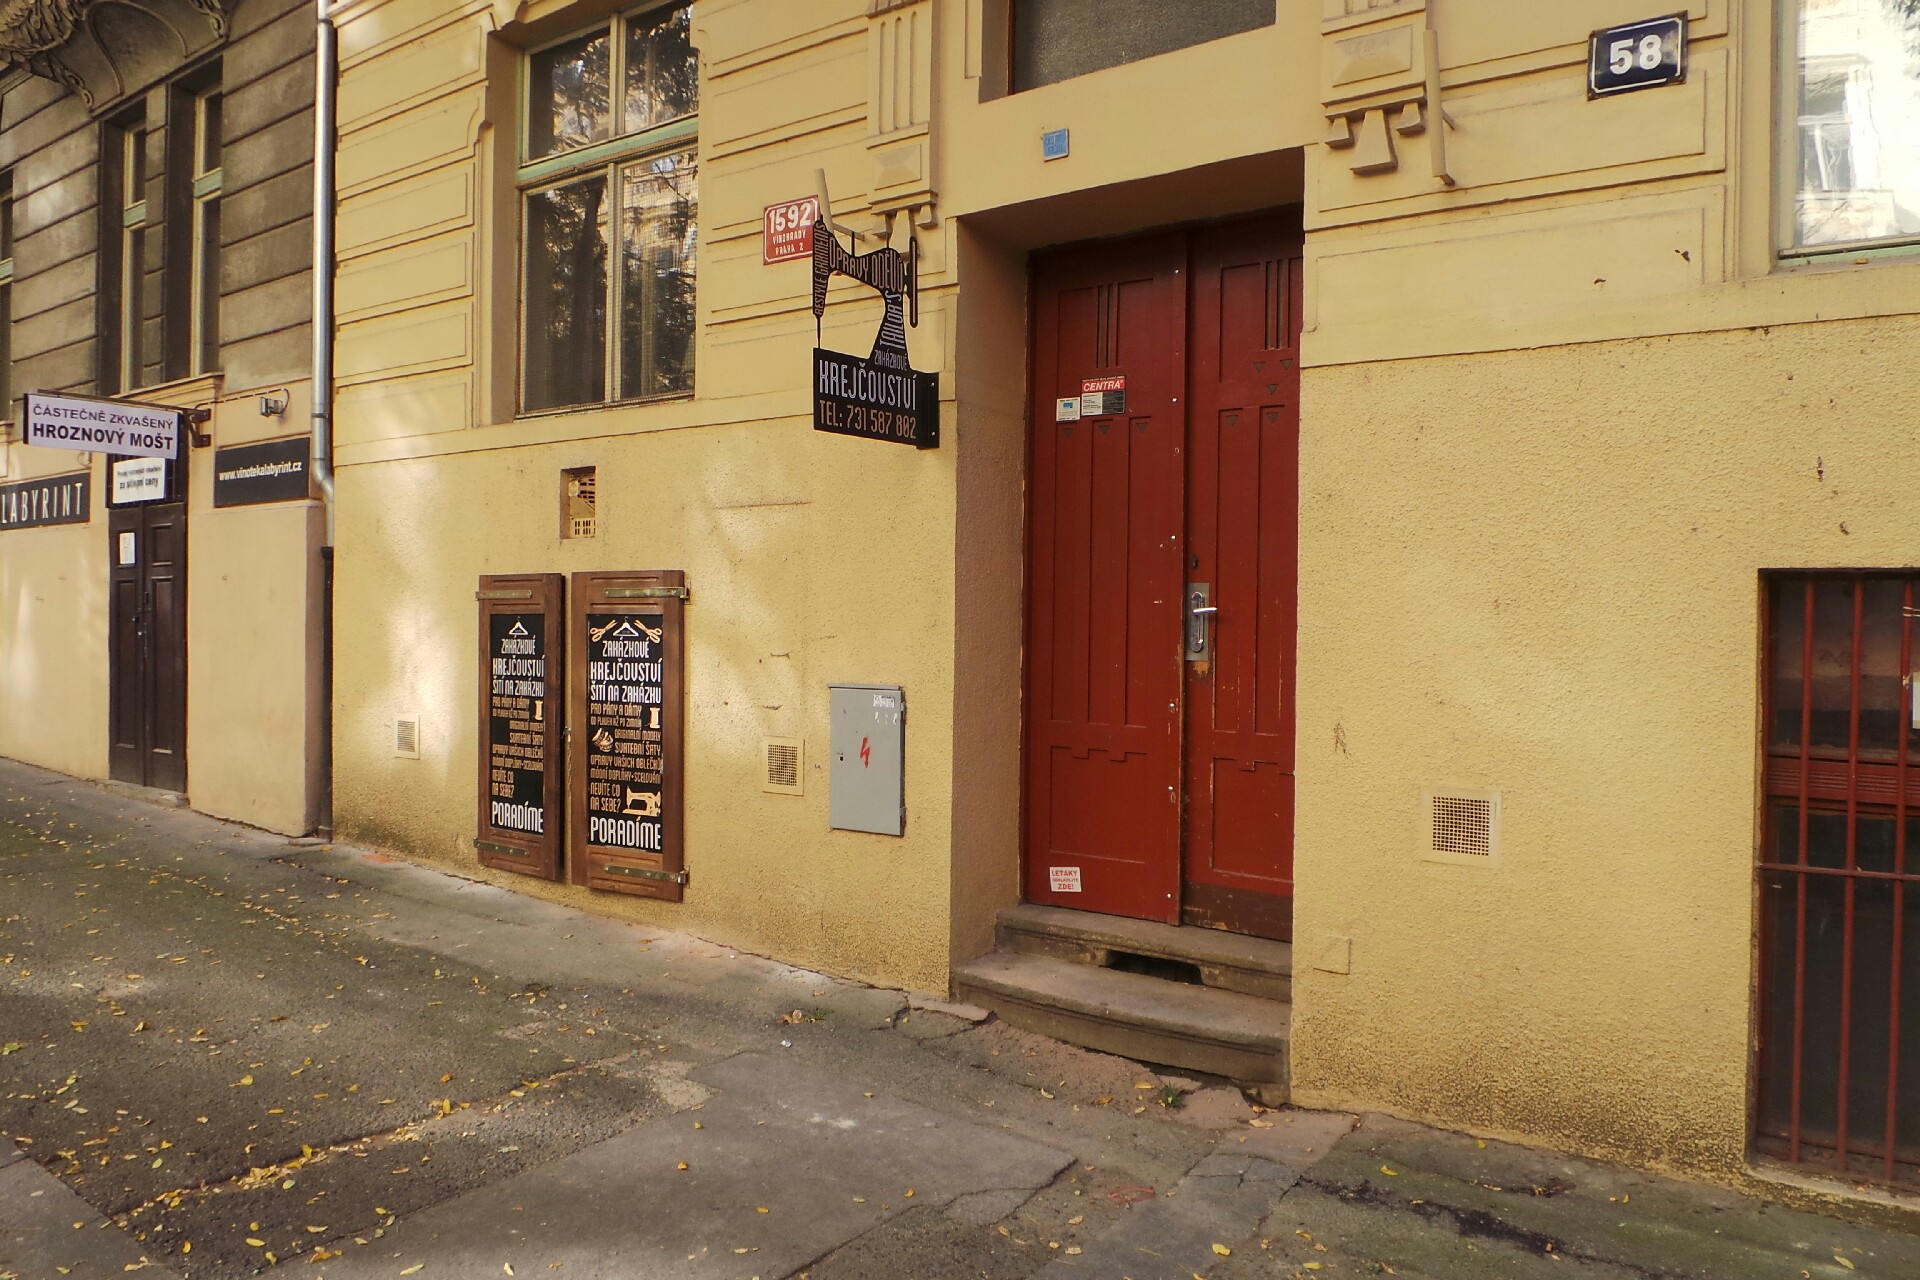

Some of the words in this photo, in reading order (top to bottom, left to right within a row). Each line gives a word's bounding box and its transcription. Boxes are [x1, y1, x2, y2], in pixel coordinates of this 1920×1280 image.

[1609, 34, 1662, 75] 58
[769, 202, 811, 234] 1592
[772, 229, 806, 245] VINOHRADY
[775, 243, 796, 256] PRAHA
[799, 242, 804, 251] 2
[829, 236, 869, 282] OPRAVY
[871, 249, 903, 293] ODĚVŮ
[874, 349, 908, 372] ZAKÁZKOVÉ
[819, 359, 918, 411] KREJČOVSTVÍ
[1083, 380, 1121, 392] CENTRA
[109, 413, 174, 430] ZKVAŠENÝ
[819, 400, 843, 427] TEL:
[846, 404, 867, 431] 731
[870, 409, 893, 435] 587
[895, 414, 917, 439] 802
[33, 422, 126, 446] HROZNOVÝ
[129, 431, 174, 450] MOŠT
[218, 460, 303, 481] www.vinotekalabyrint.cz
[1, 482, 83, 524] LABYRINT
[501, 635, 536, 655] ZAKÁZKOVÉ
[602, 636, 650, 659] ZAKÁZKOVÉ
[492, 654, 546, 678] KREJČOVSTVÍ
[590, 657, 663, 683] KREJČOVSTVÍ
[514, 677, 544, 698] ZAKÁZKU
[590, 680, 606, 701] ŠITÍ
[607, 684, 620, 702] NA
[621, 683, 662, 704] ZAKÁZKU
[590, 703, 602, 715] PRO
[614, 740, 645, 756] SVATEBNÍ
[645, 741, 661, 757] ŠATY
[590, 754, 613, 767] OPRAVY
[590, 780, 611, 797] NEVÍTE
[611, 784, 621, 798] CO
[491, 800, 544, 833] PORADÍME
[590, 796, 600, 811] NA
[600, 798, 621, 814] SEBE?
[590, 815, 661, 850] PORADÍME
